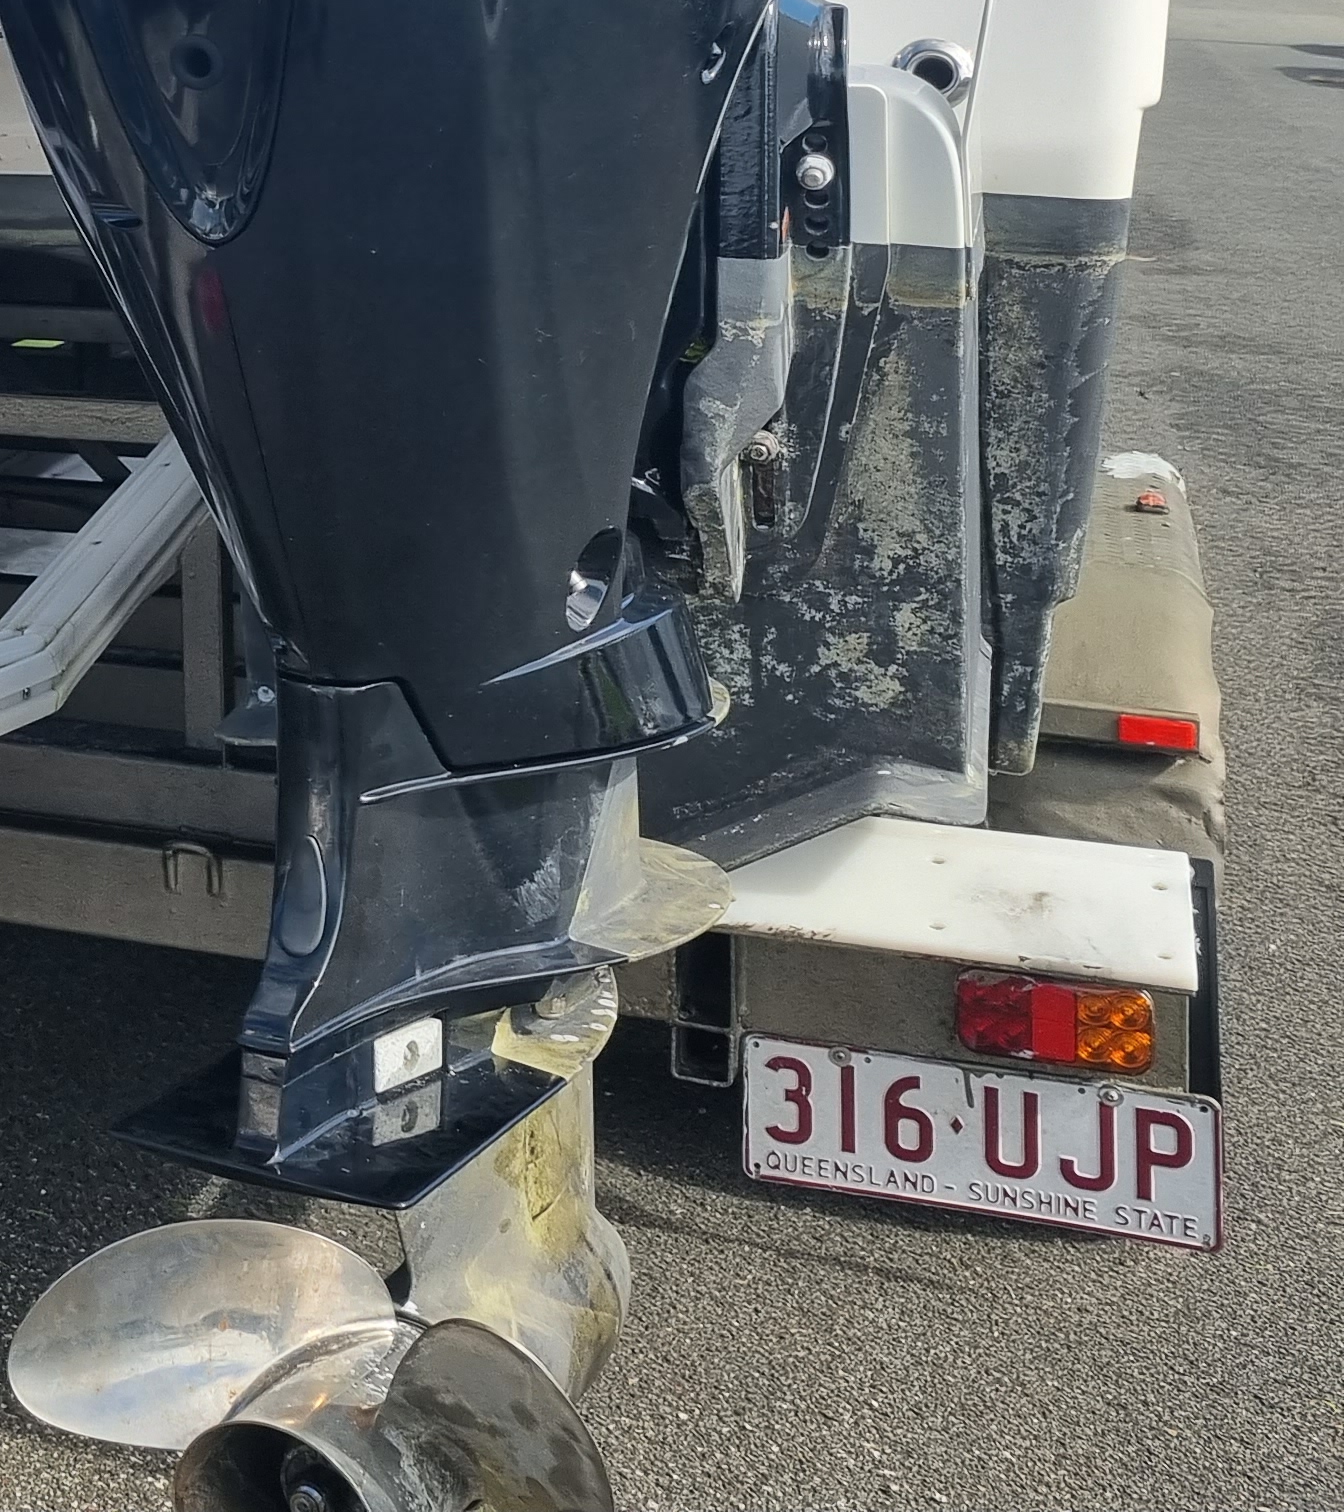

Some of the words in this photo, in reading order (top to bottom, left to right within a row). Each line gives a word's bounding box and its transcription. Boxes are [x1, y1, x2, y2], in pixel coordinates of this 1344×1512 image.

[766, 1149, 938, 1194] QUEENSLAND
[968, 1180, 1099, 1221] SUNSHINE
[1114, 1203, 1200, 1239] STATE
